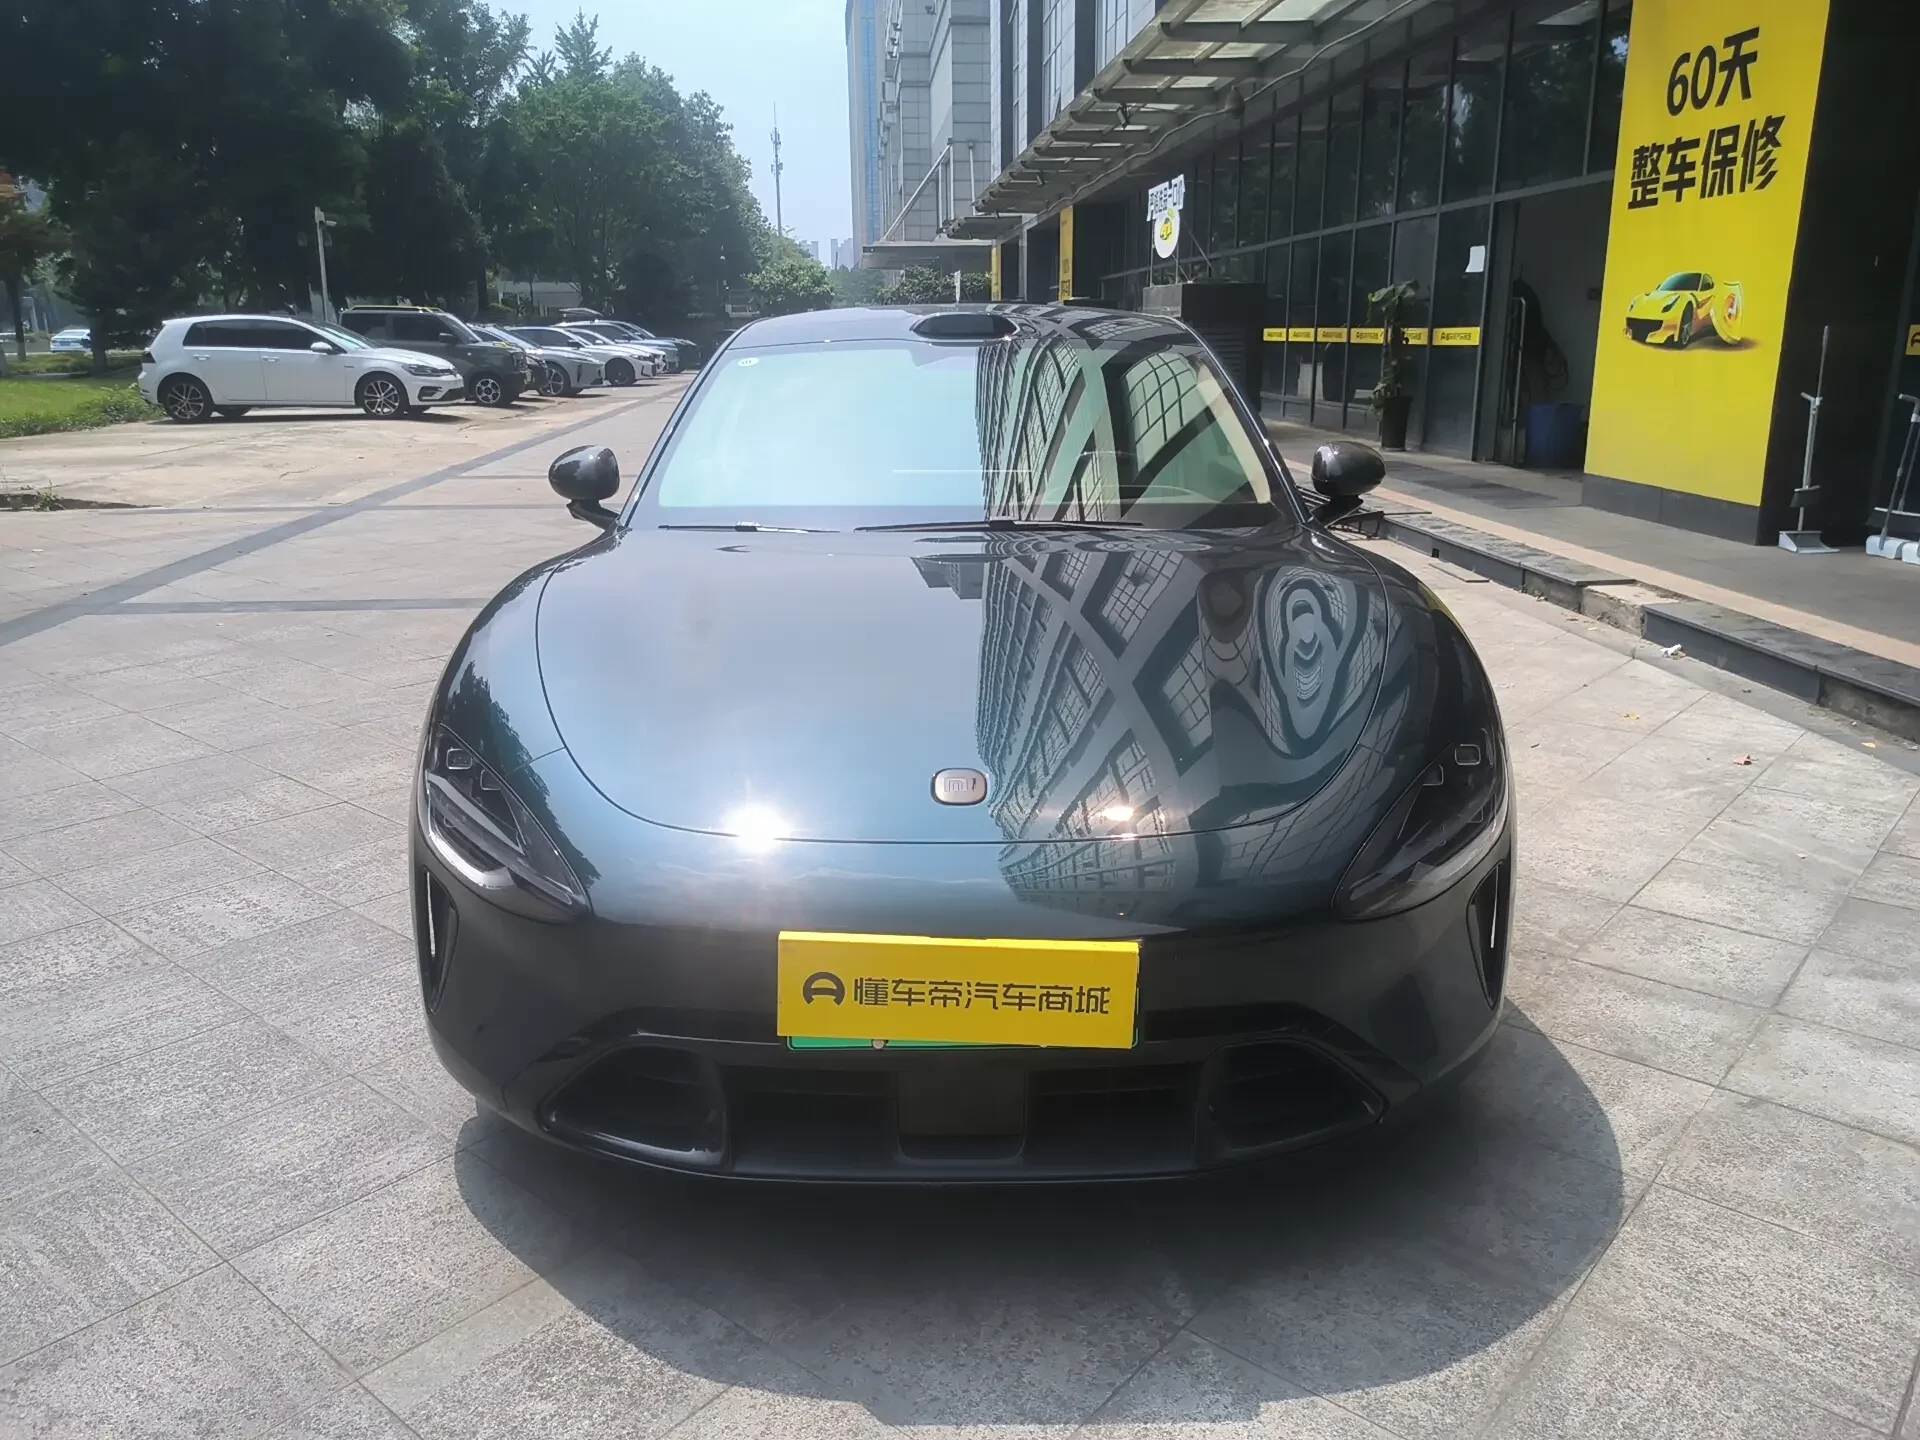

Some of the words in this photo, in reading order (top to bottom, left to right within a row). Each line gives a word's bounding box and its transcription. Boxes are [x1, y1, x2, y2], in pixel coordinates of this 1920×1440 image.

[1666, 26, 1760, 117] 60天
[1627, 115, 1786, 210] 整车保修
[853, 976, 1111, 1015] 懂车帝汽车商城
